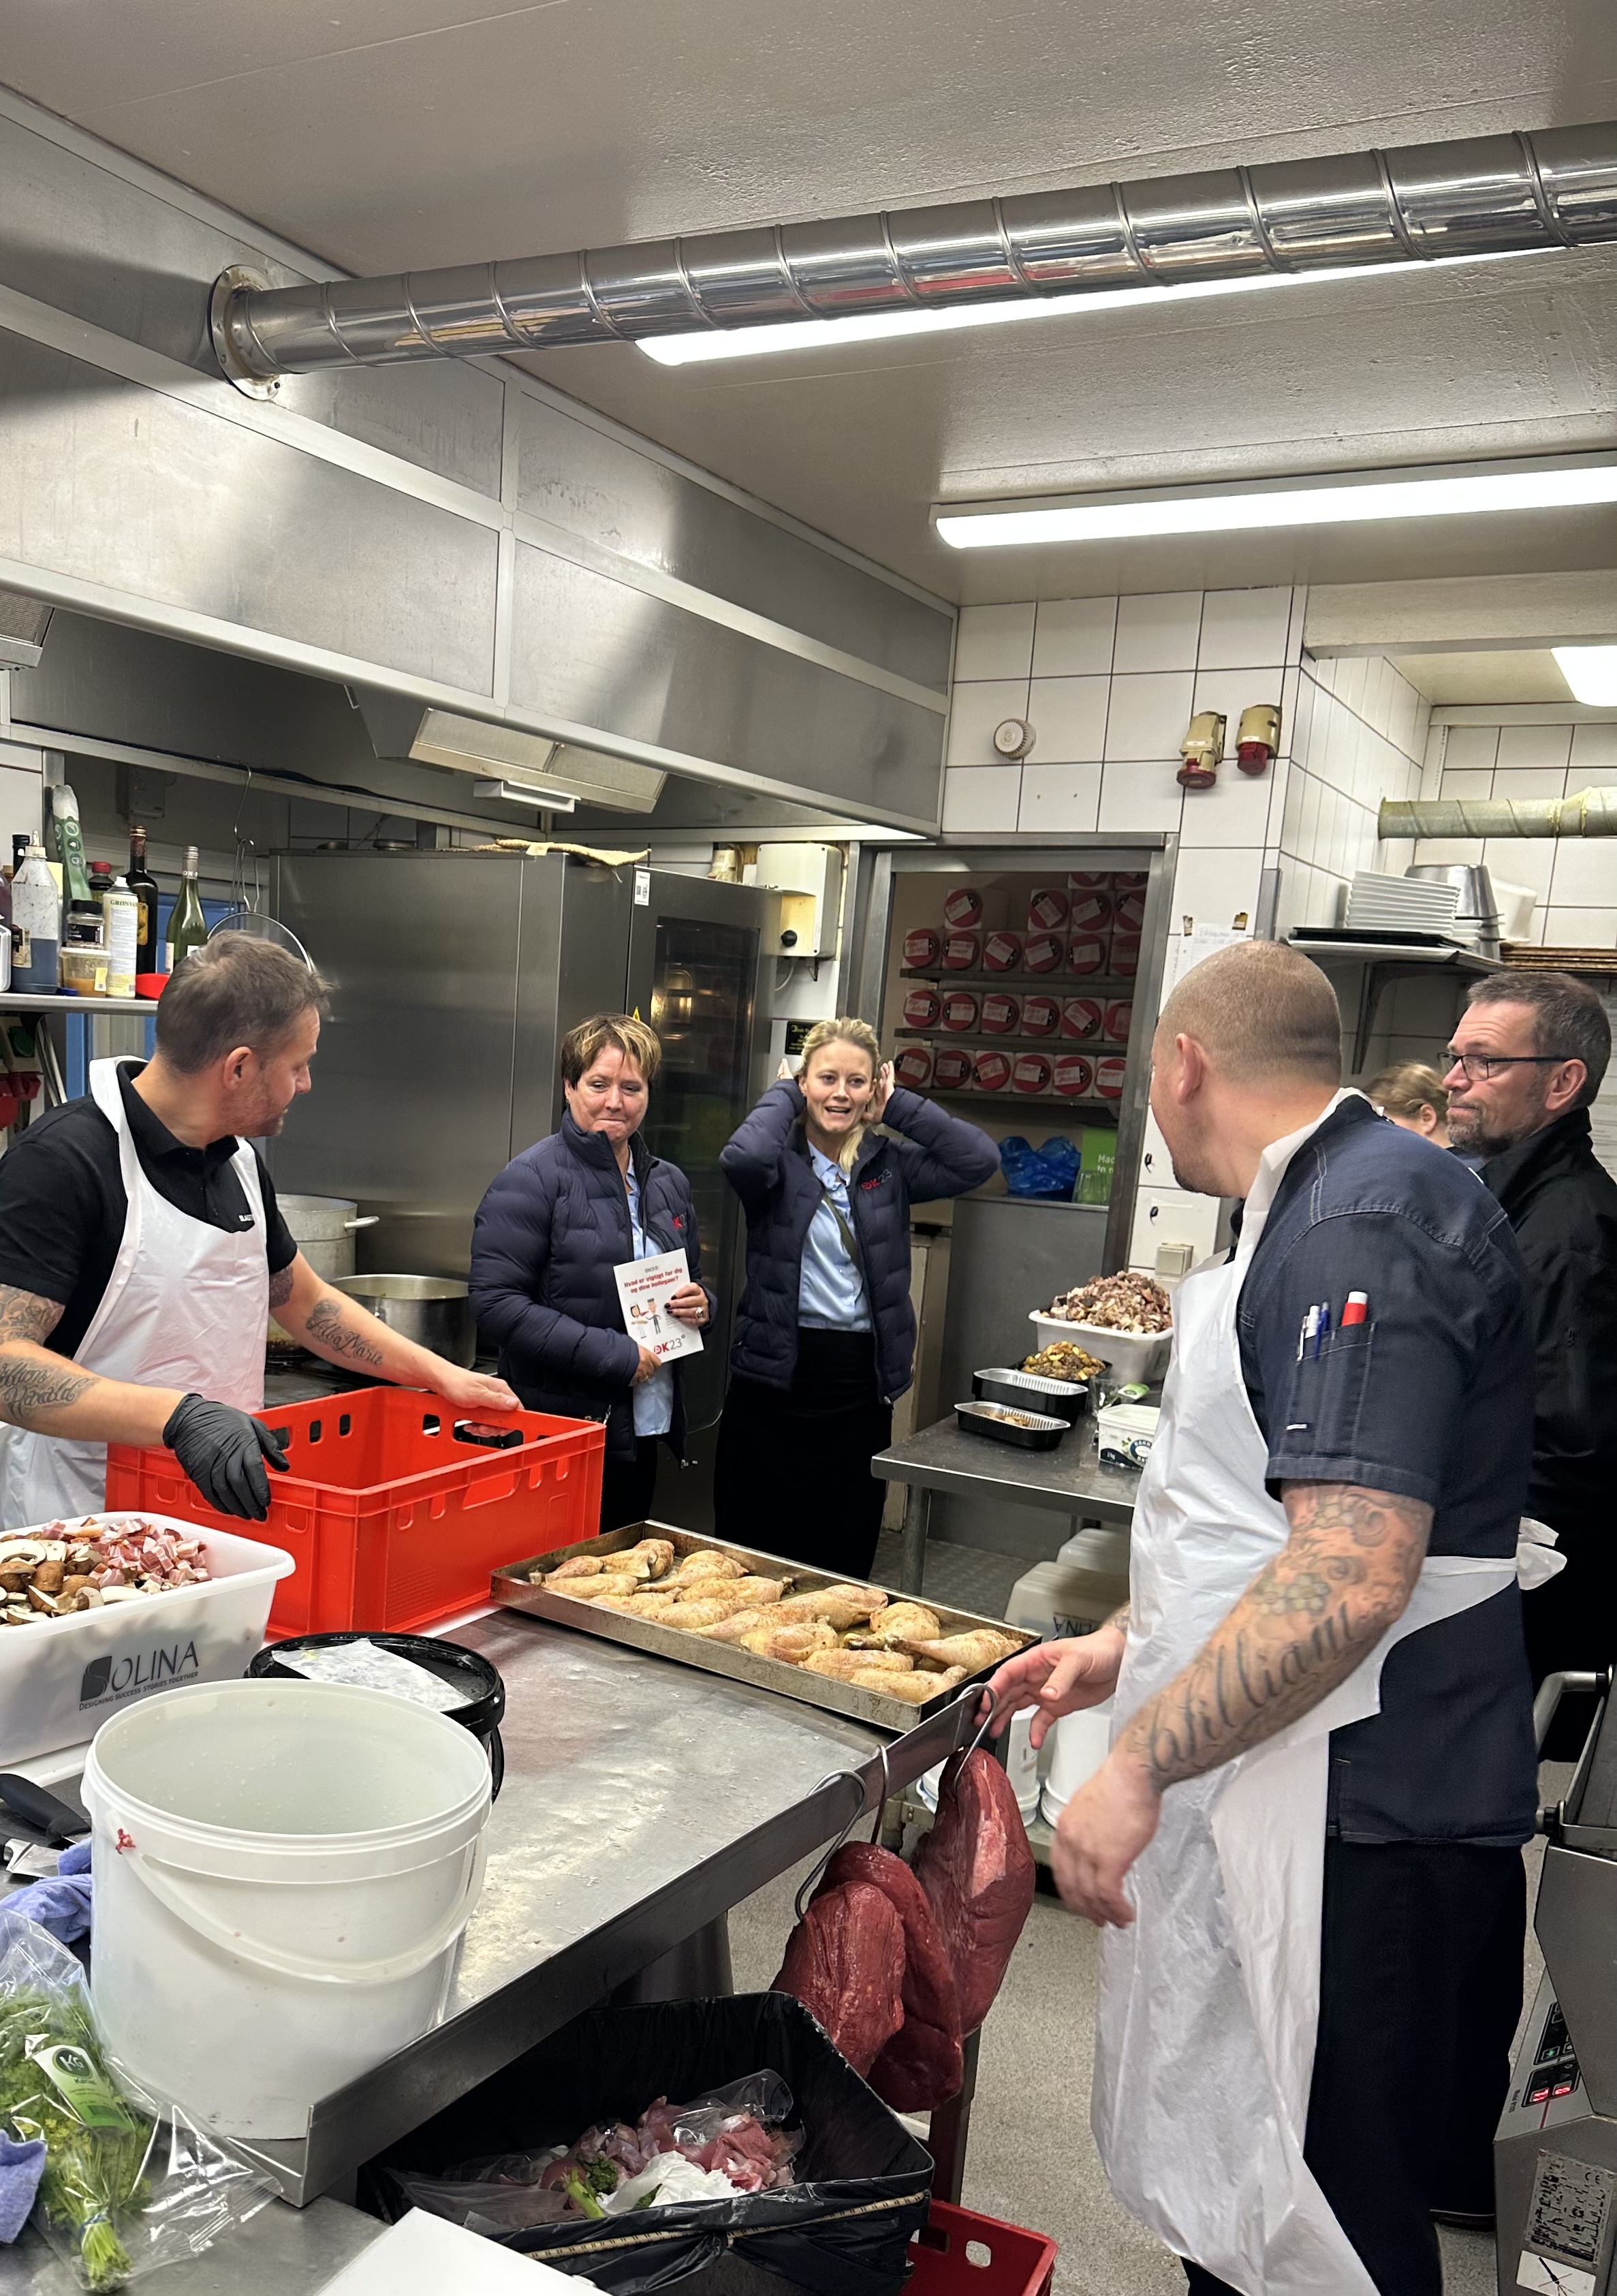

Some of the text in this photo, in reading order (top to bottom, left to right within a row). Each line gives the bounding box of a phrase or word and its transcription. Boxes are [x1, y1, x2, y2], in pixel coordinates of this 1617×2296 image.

[624, 1279, 638, 1288] Hvad
[646, 1273, 665, 1282] vigtigt
[639, 1283, 650, 1291] dine
[341, 1330, 383, 1366] Marie
[653, 1337, 682, 1354] OK23
[78, 1671, 200, 1711] DESIGNING SUCCESS STORIES TOGETHER
[1148, 1601, 1354, 1773] William
